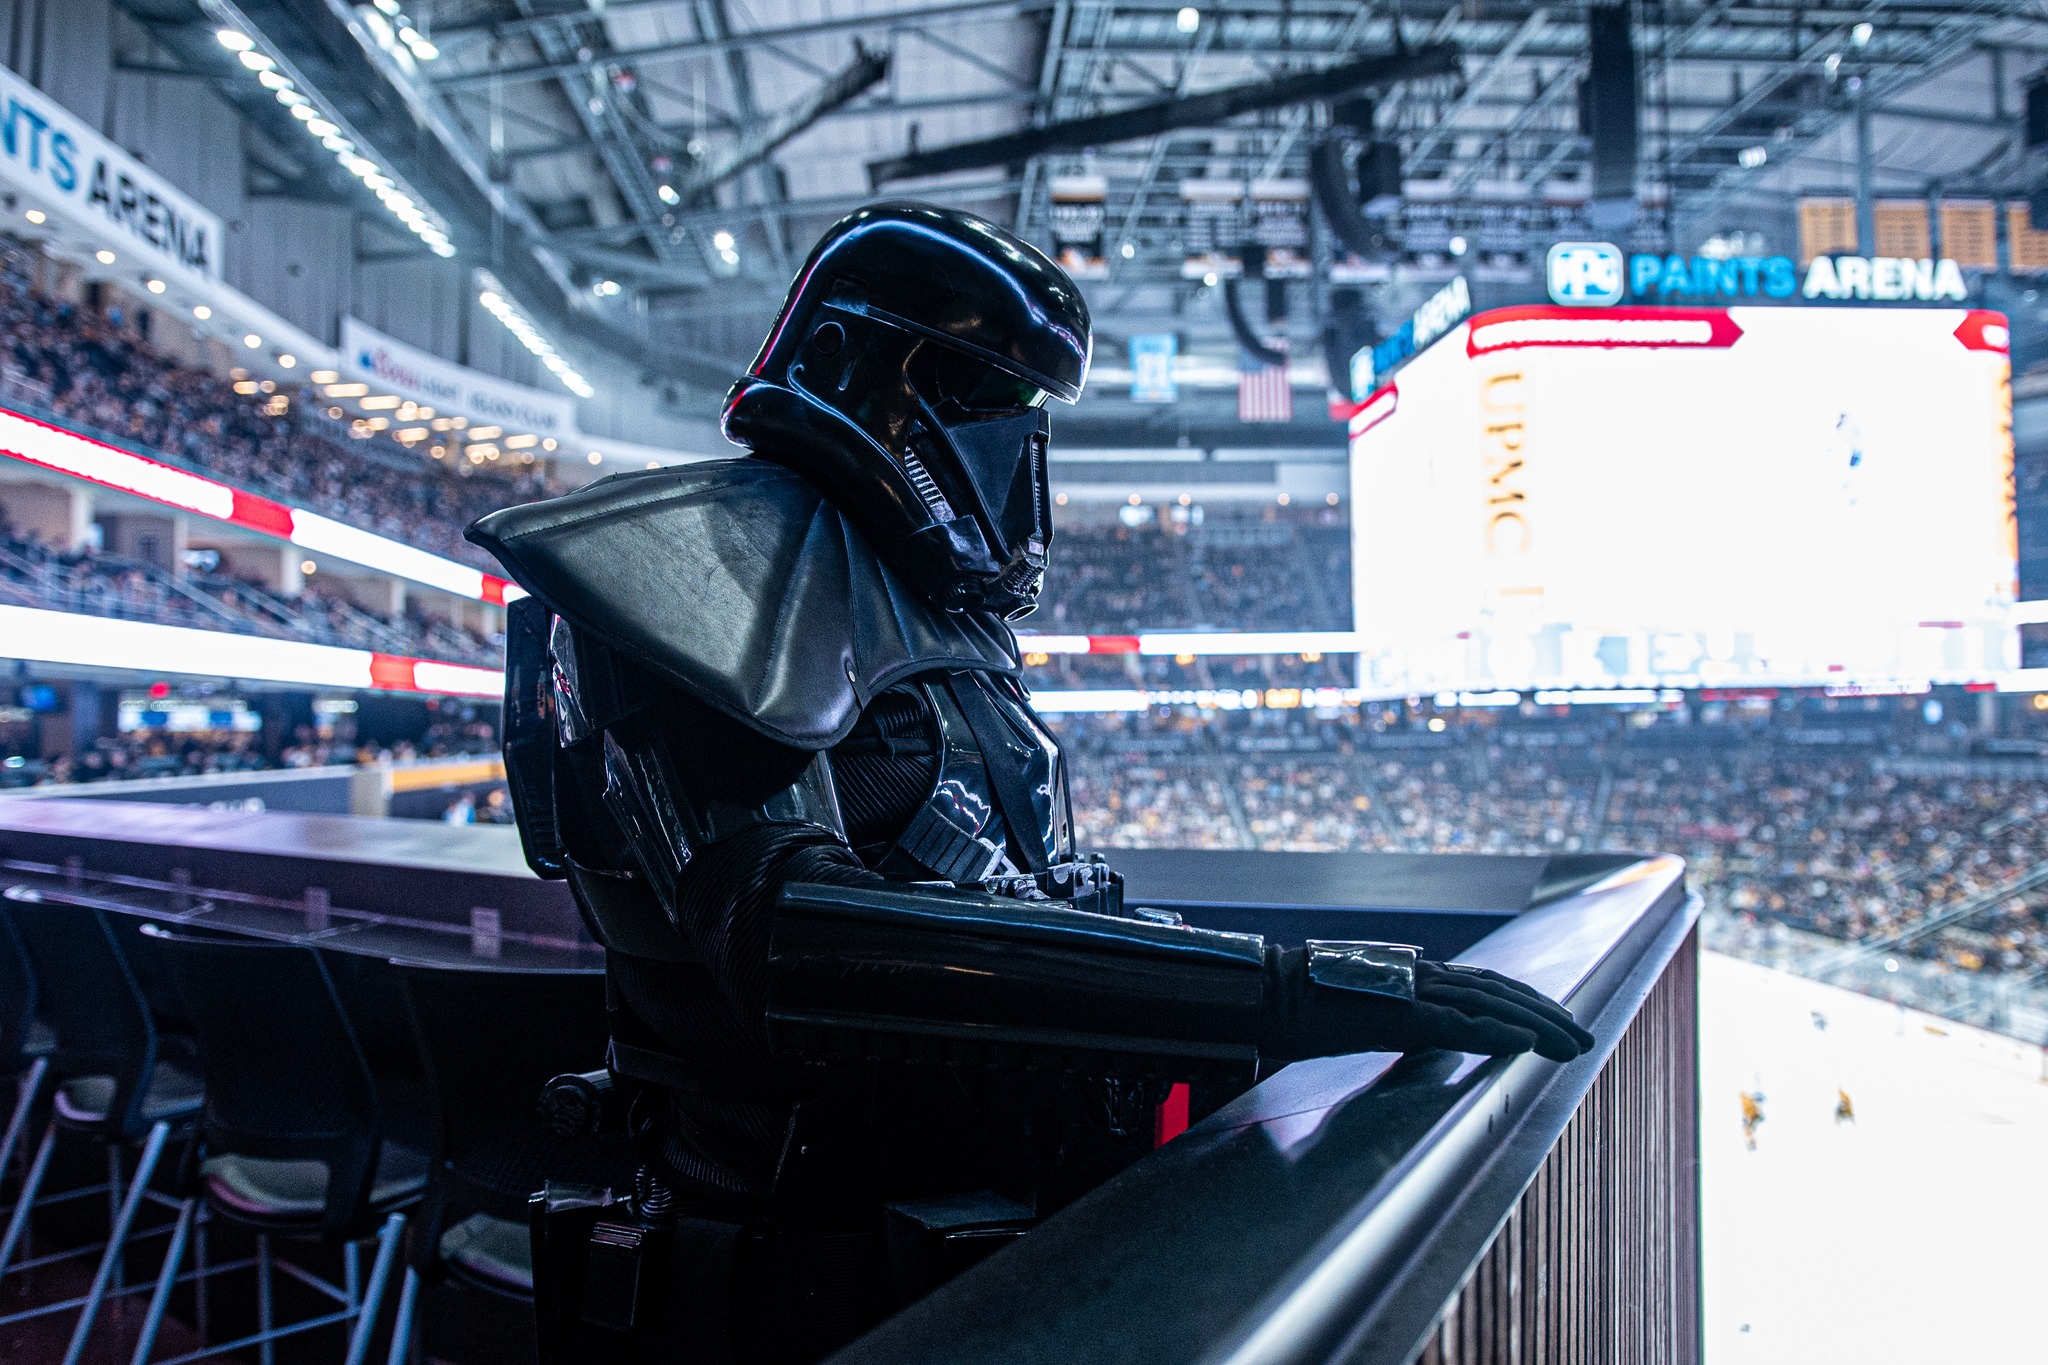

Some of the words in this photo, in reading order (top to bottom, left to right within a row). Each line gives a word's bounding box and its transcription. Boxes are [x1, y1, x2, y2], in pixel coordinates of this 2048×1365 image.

[86, 157, 209, 273] ARENA
[1630, 254, 1796, 298] PAINTS
[1802, 255, 1967, 300] ARENA
[1480, 373, 1530, 553] UPMC
